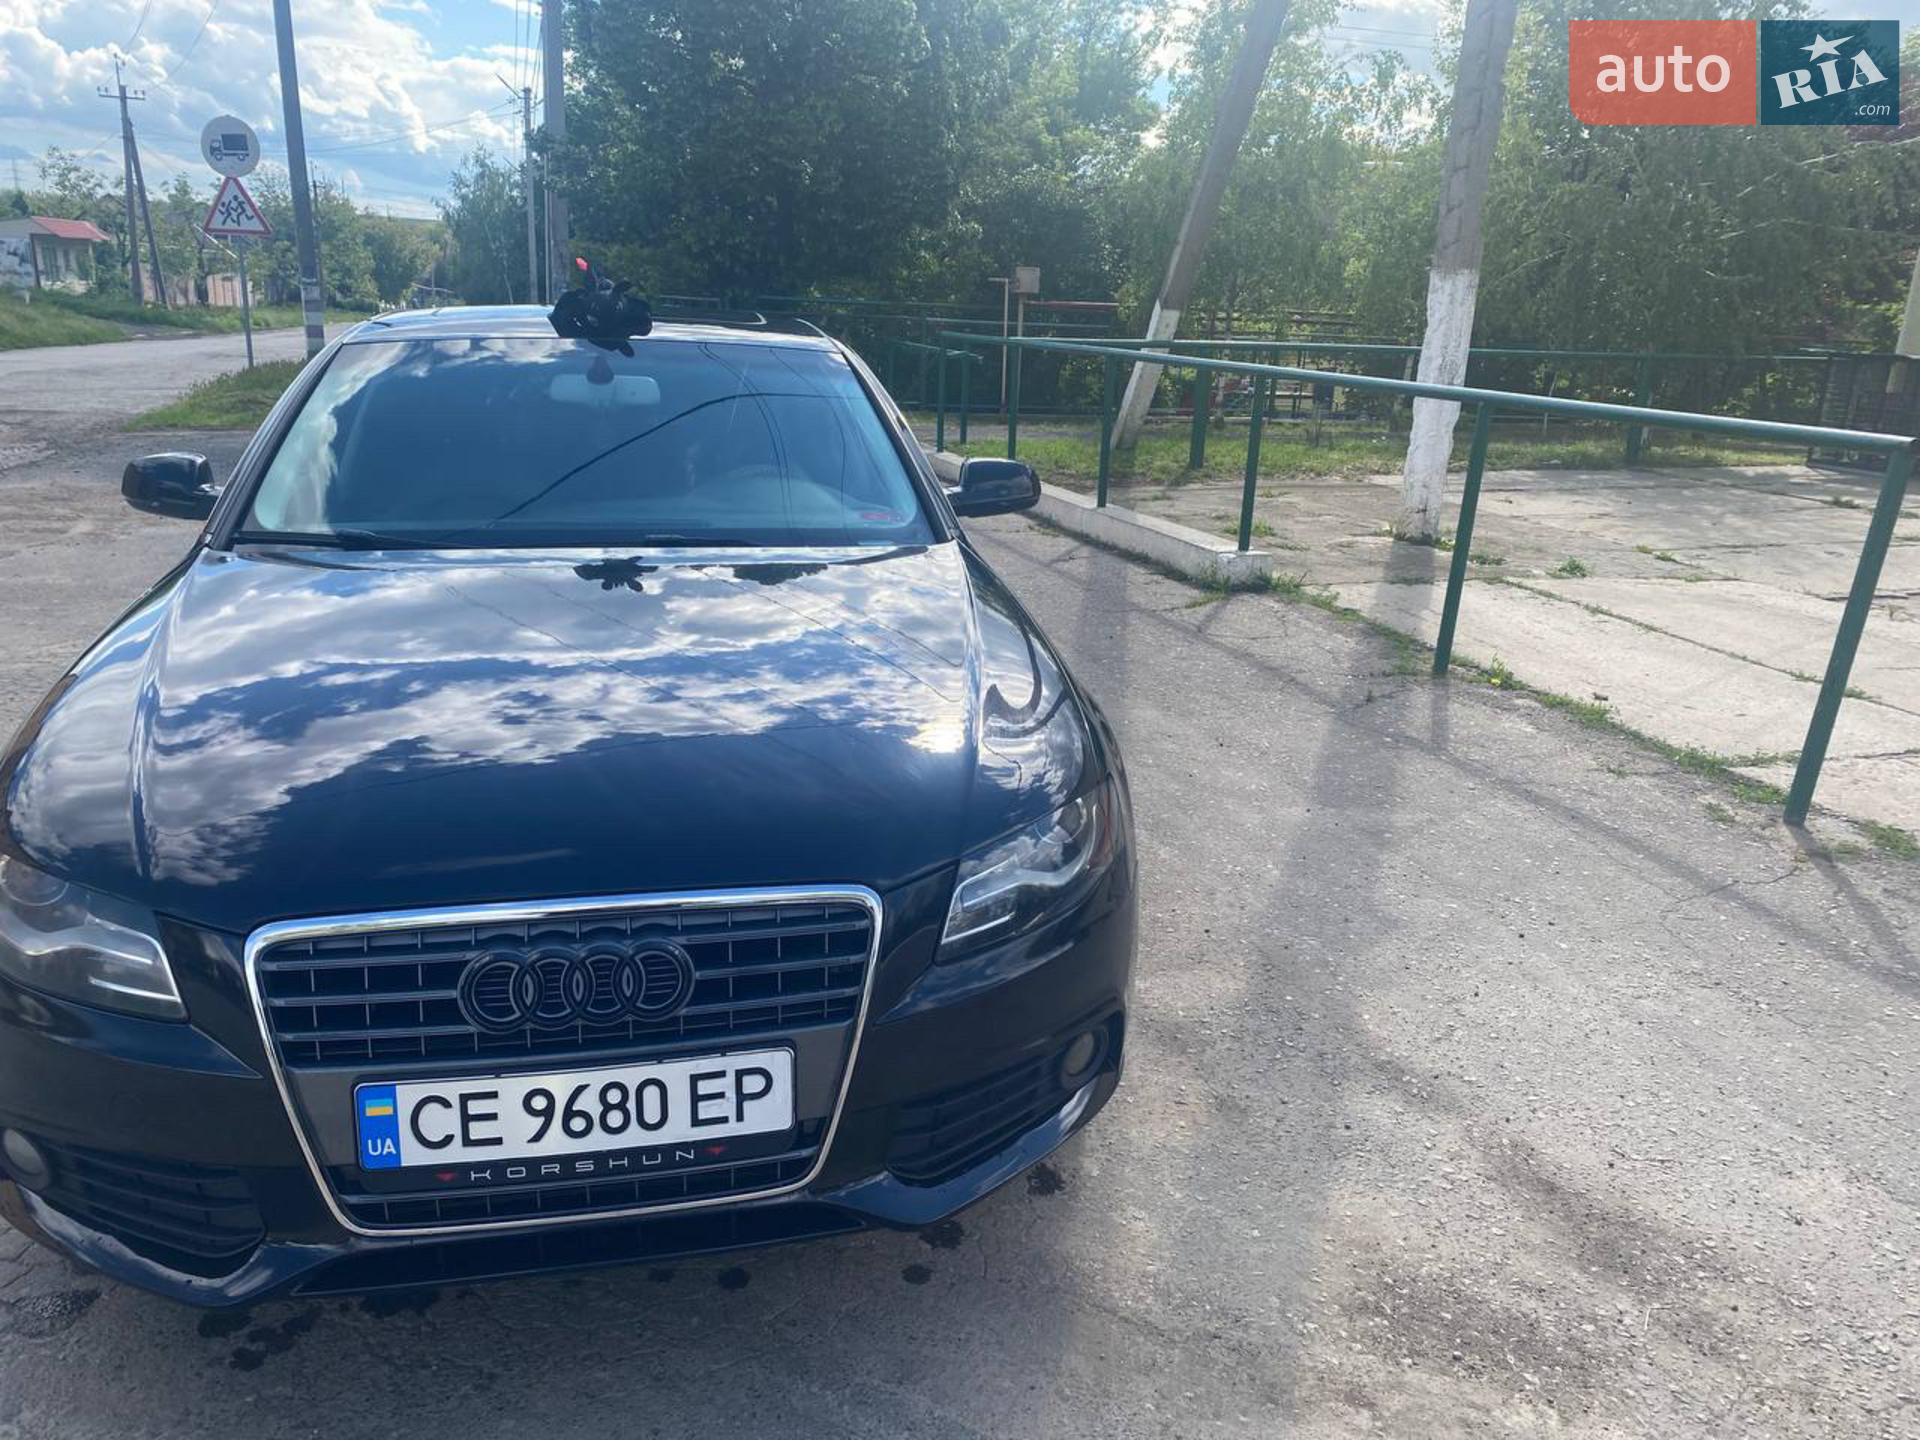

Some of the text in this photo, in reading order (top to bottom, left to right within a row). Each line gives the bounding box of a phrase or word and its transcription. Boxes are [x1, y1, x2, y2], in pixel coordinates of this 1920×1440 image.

[409, 1065, 774, 1150] CE 9680 EP
[367, 1138, 397, 1157] UA
[470, 1148, 695, 1182] KORSHUN
